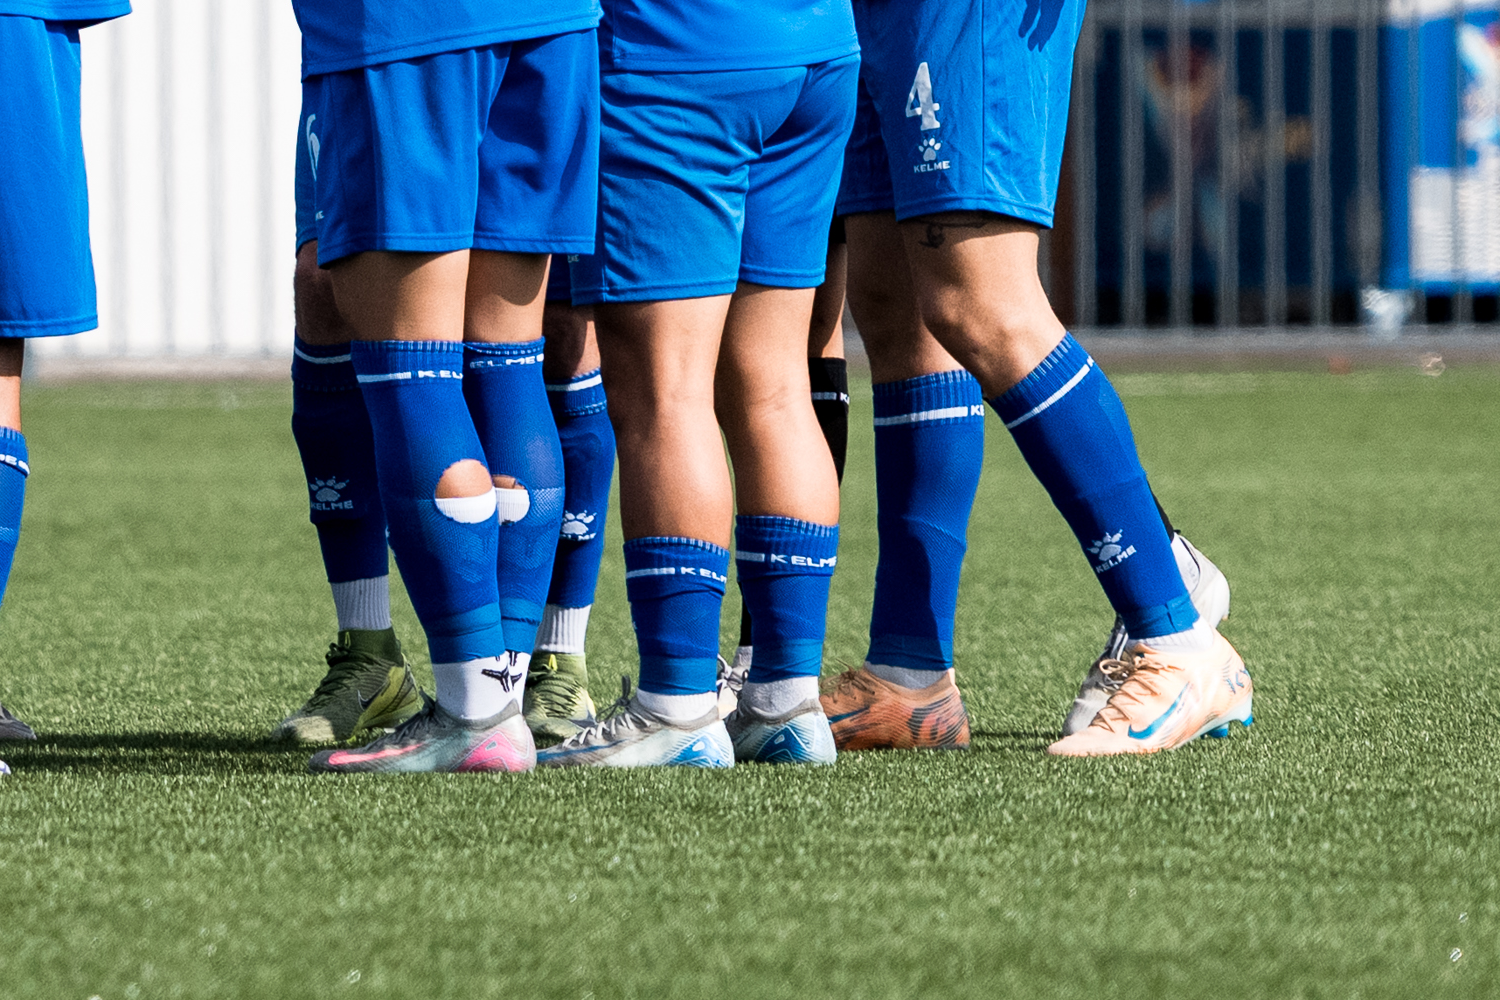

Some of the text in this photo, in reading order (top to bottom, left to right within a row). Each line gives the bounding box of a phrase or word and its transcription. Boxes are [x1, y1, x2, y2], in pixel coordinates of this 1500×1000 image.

[905, 62, 940, 131] 4
[913, 160, 951, 173] KELME
[310, 499, 354, 511] KELME
[1095, 544, 1137, 574] KELME
